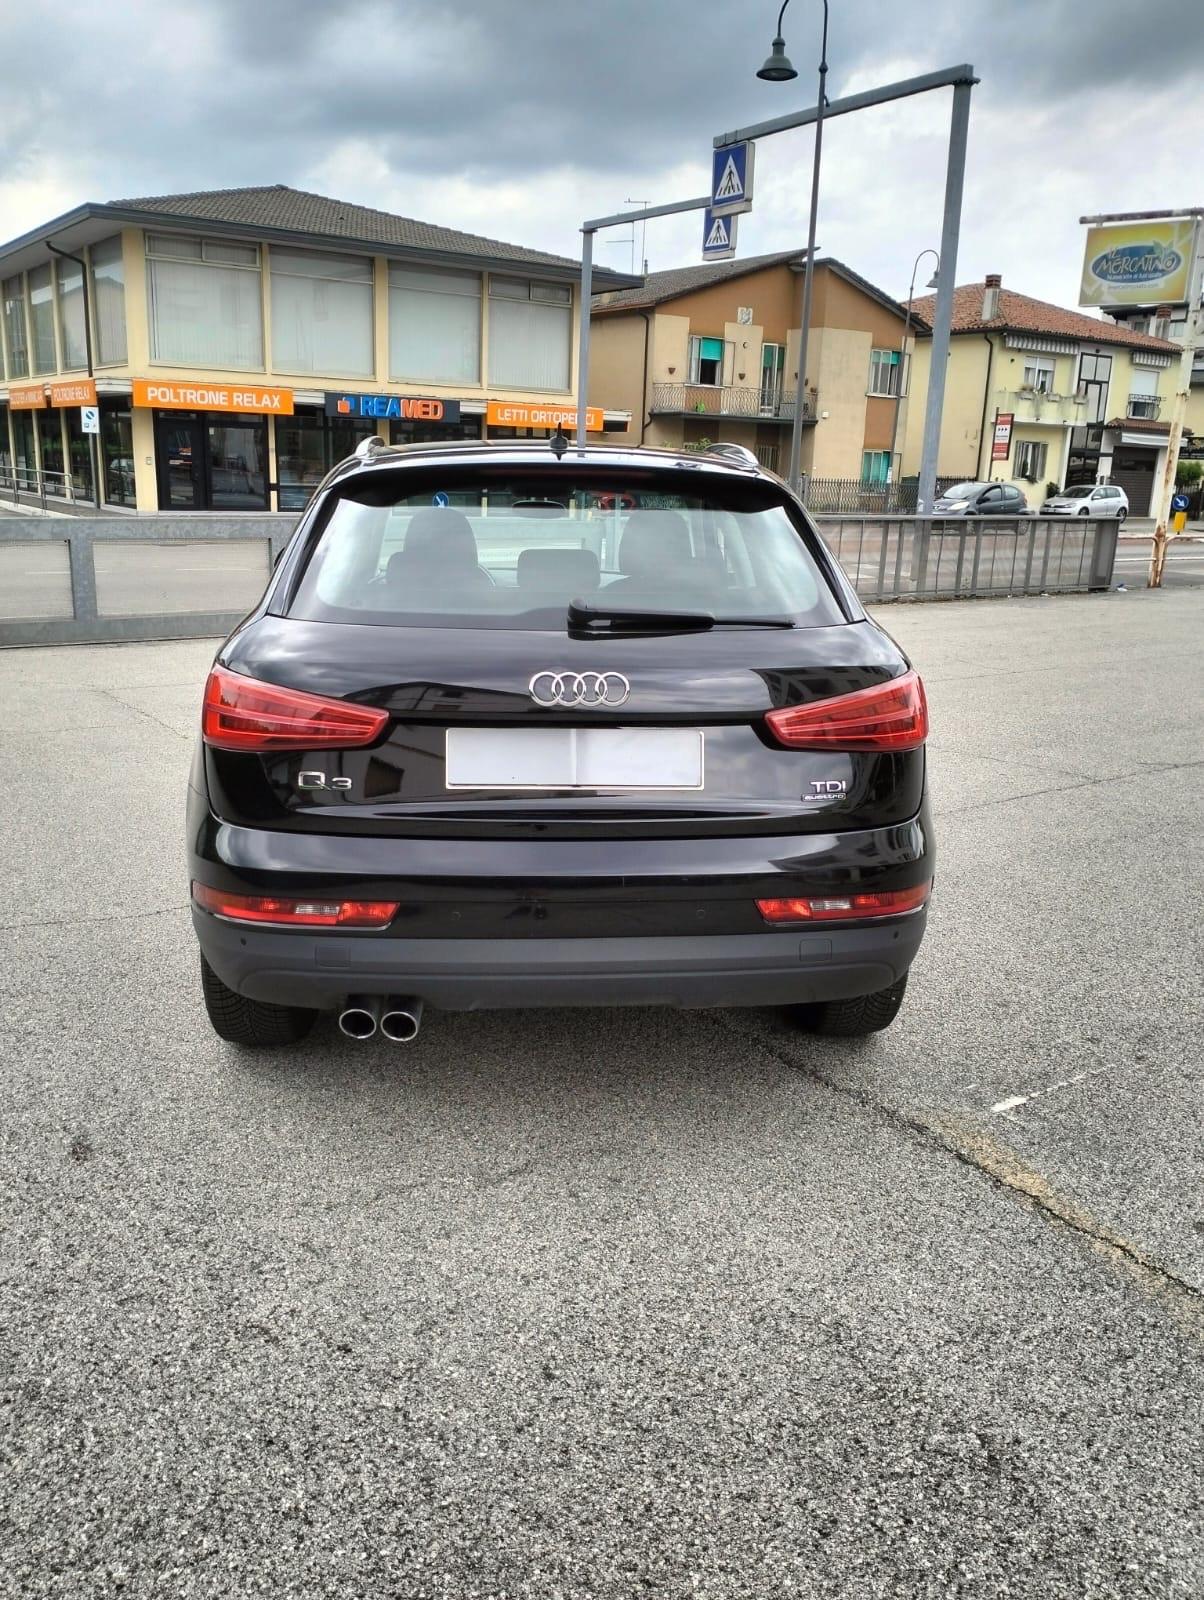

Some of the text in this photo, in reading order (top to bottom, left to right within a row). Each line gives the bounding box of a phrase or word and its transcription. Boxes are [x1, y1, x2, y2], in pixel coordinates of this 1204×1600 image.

[1096, 253, 1177, 274] MERCATINO
[147, 387, 280, 408] POLTRONE RELAX
[360, 396, 443, 420] REAMED
[497, 408, 595, 426] LETTI ORTOPECI
[298, 771, 352, 790] Q3
[810, 780, 847, 793] TDI
